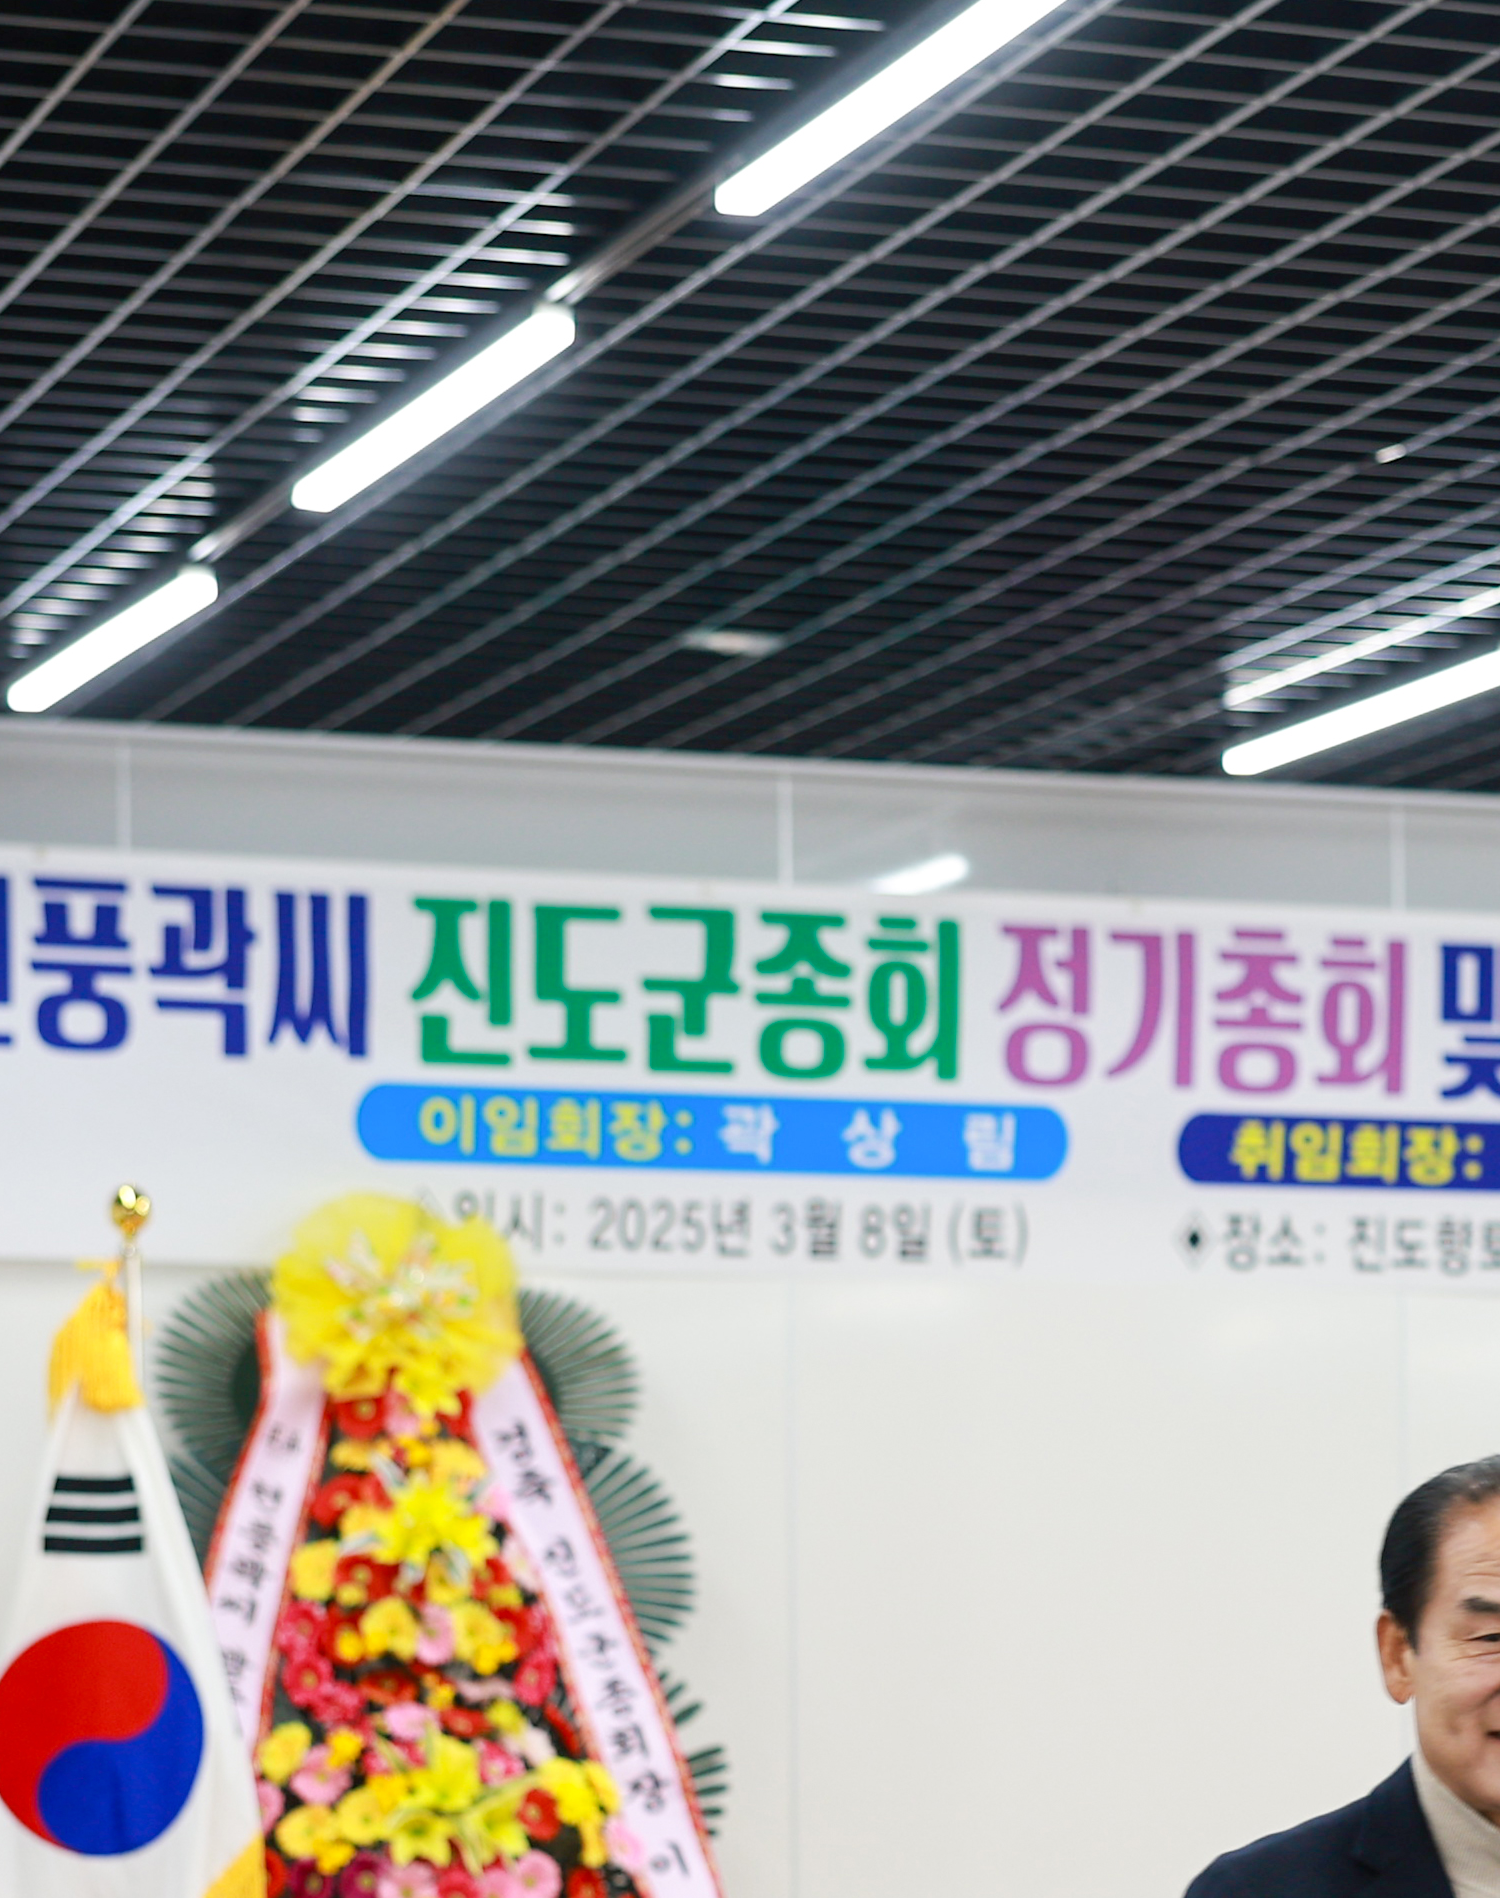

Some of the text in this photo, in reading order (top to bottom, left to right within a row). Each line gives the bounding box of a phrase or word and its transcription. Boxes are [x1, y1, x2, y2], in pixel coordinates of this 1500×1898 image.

[409, 898, 960, 1080] 진도군종회
[997, 925, 1406, 1096] 정기총회
[1230, 1118, 1485, 1186] 취임회장:
[588, 1196, 754, 1258] 2025년
[769, 1203, 843, 1260] 3월
[860, 1204, 933, 1262] 8일
[948, 1200, 1030, 1268] (토)
